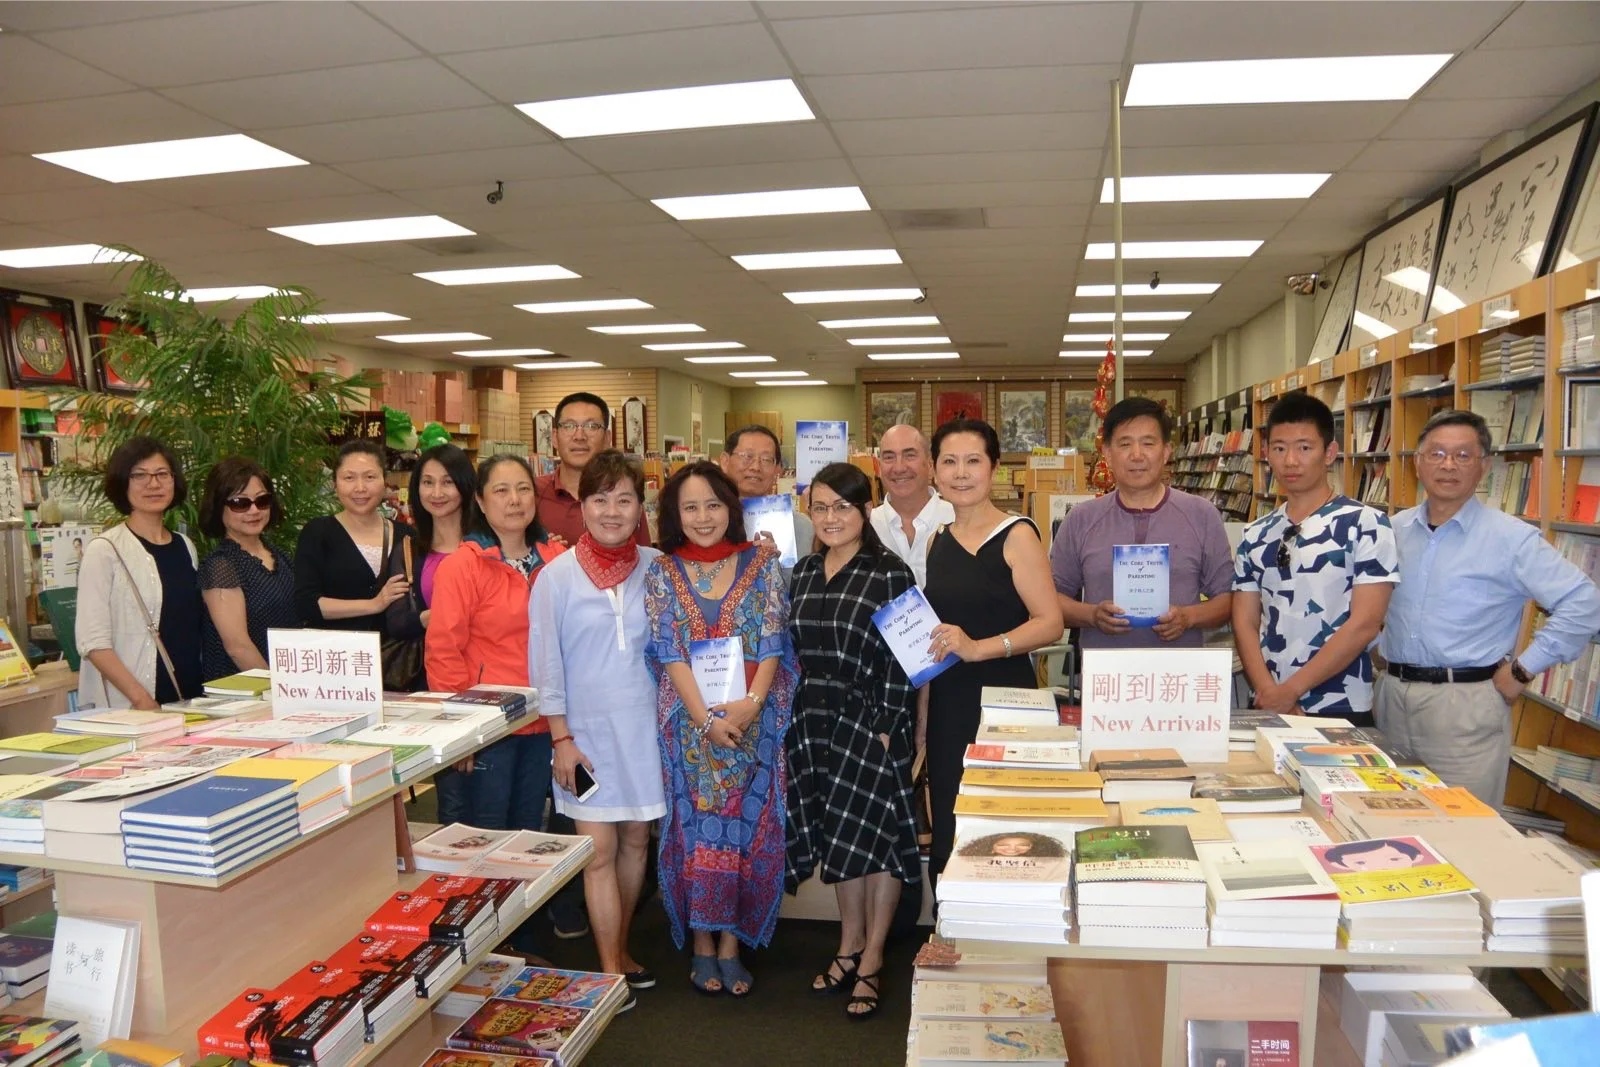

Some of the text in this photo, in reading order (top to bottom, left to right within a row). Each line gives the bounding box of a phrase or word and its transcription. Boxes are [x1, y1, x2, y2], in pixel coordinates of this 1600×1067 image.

[275, 648, 373, 677] 剛到新書
[278, 683, 376, 702] New Arrivals
[1092, 672, 1222, 703] 剛到新書
[1092, 715, 1222, 732] New Arrivals
[1251, 1040, 1290, 1050] 二手时间
